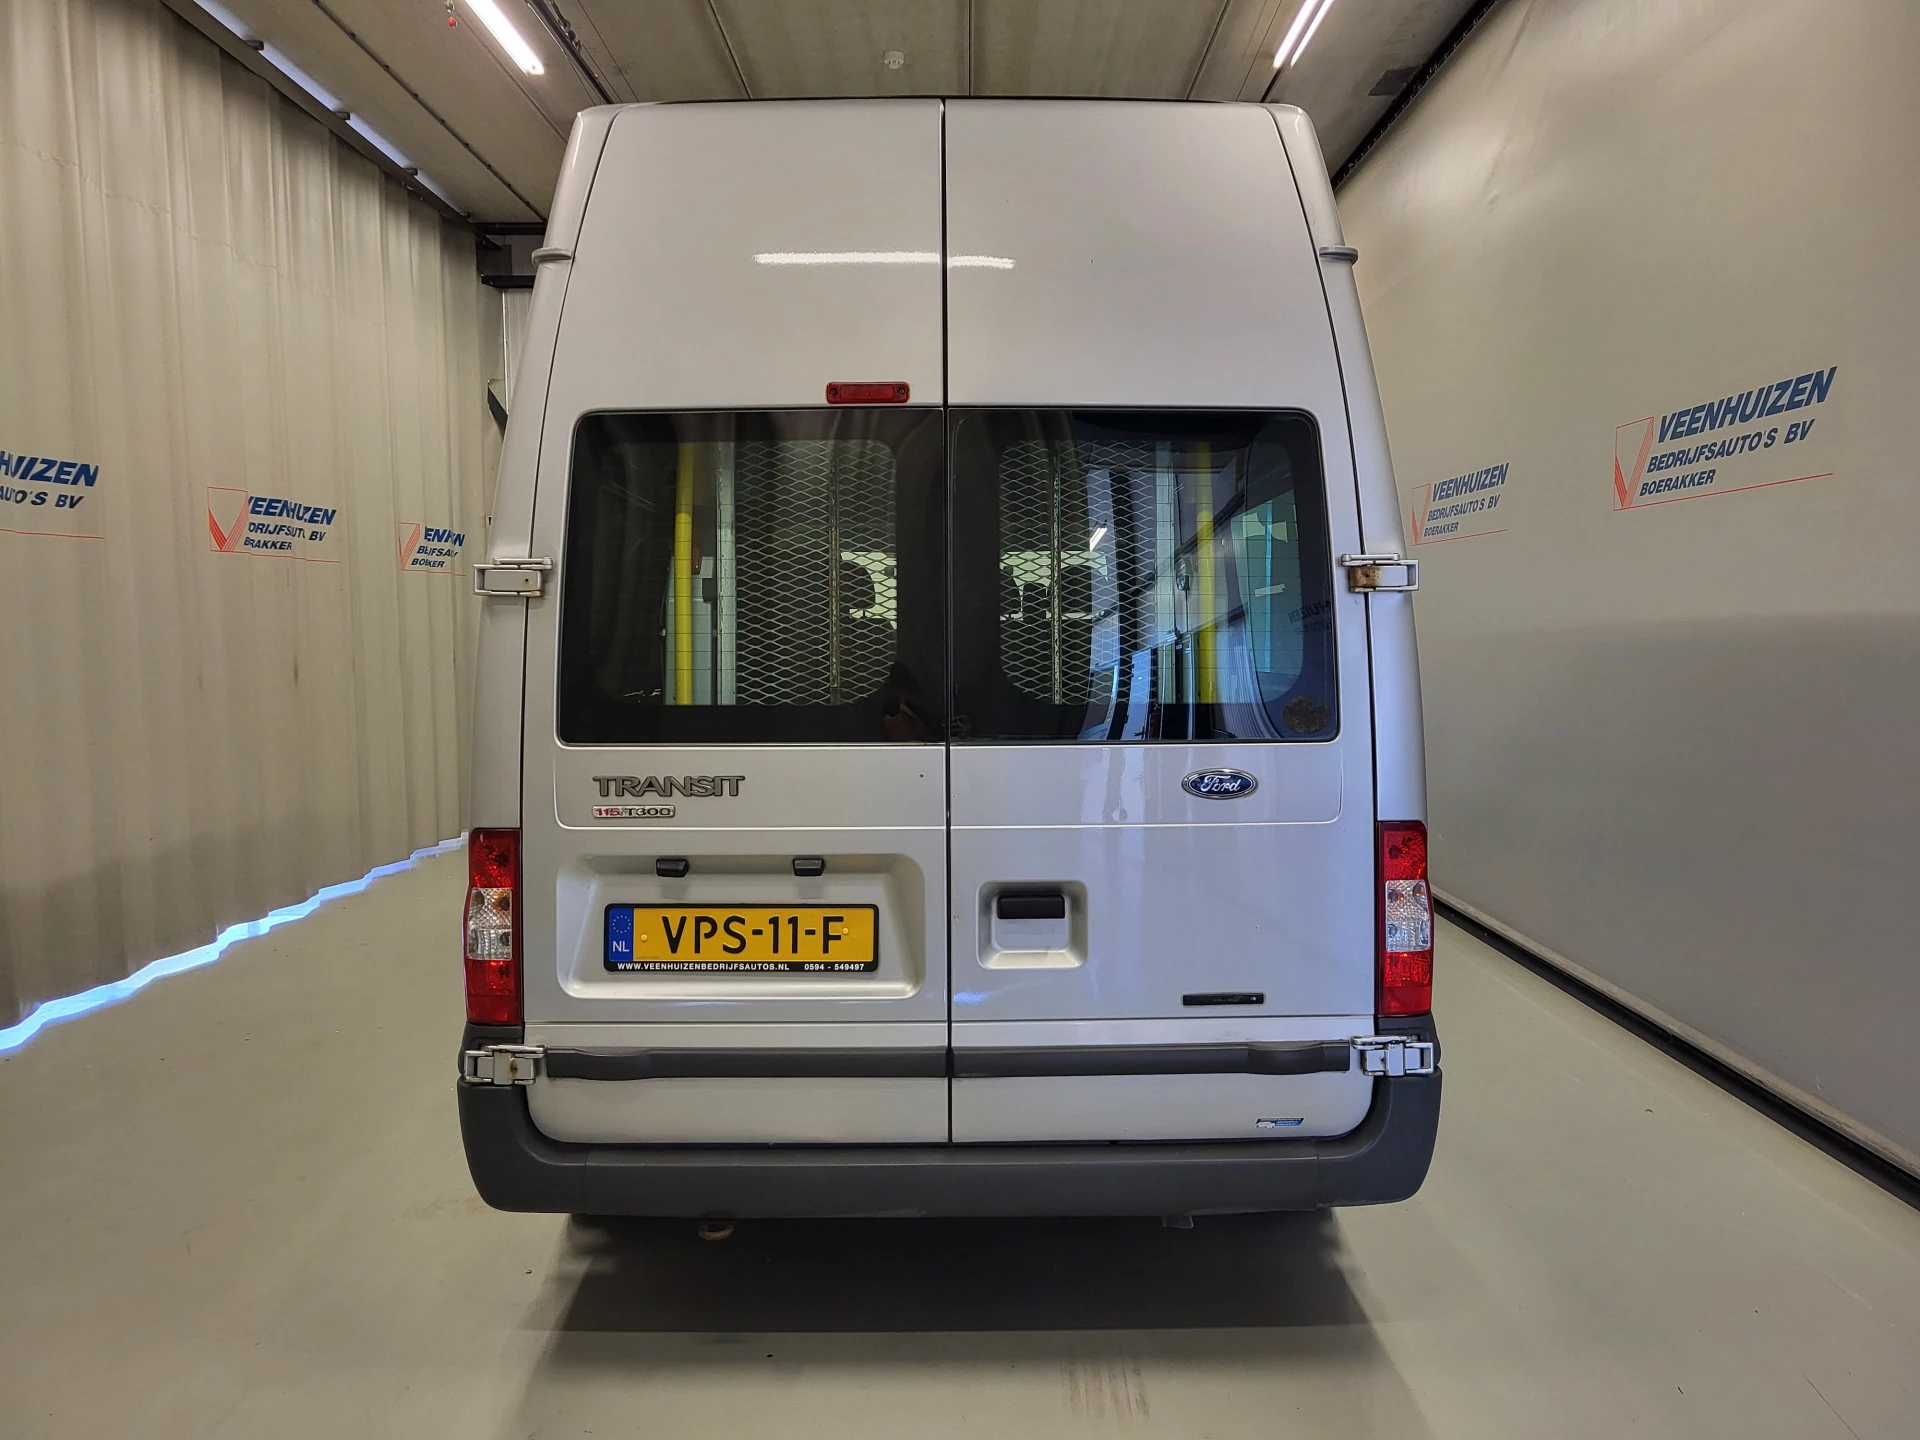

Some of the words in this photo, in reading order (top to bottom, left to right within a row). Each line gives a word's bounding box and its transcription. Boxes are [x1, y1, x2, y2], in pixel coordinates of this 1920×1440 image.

[1658, 366, 1838, 444] VEENHUIZEN
[1647, 427, 1778, 474] BEDRIJFSAUTO'S
[1784, 418, 1815, 445] BV
[1432, 462, 1509, 503] VEENHUIZEN
[1639, 469, 1716, 497] BOERAKKER
[55, 493, 85, 509] BV
[1427, 498, 1486, 522] BEDRIJFSAUTO'S
[1487, 494, 1501, 510] BV
[309, 530, 326, 542] BV
[1424, 522, 1459, 538] BOERAKKER
[592, 775, 746, 798] TRANSIT
[1200, 775, 1242, 792] Ford
[661, 915, 845, 954] VPS-11-F
[612, 940, 630, 953] NL
[617, 962, 790, 972] WWW.VEENHUIZENBEDRIJFSAUTOS.NL
[804, 963, 825, 972] 0594
[834, 963, 865, 972] 549497
